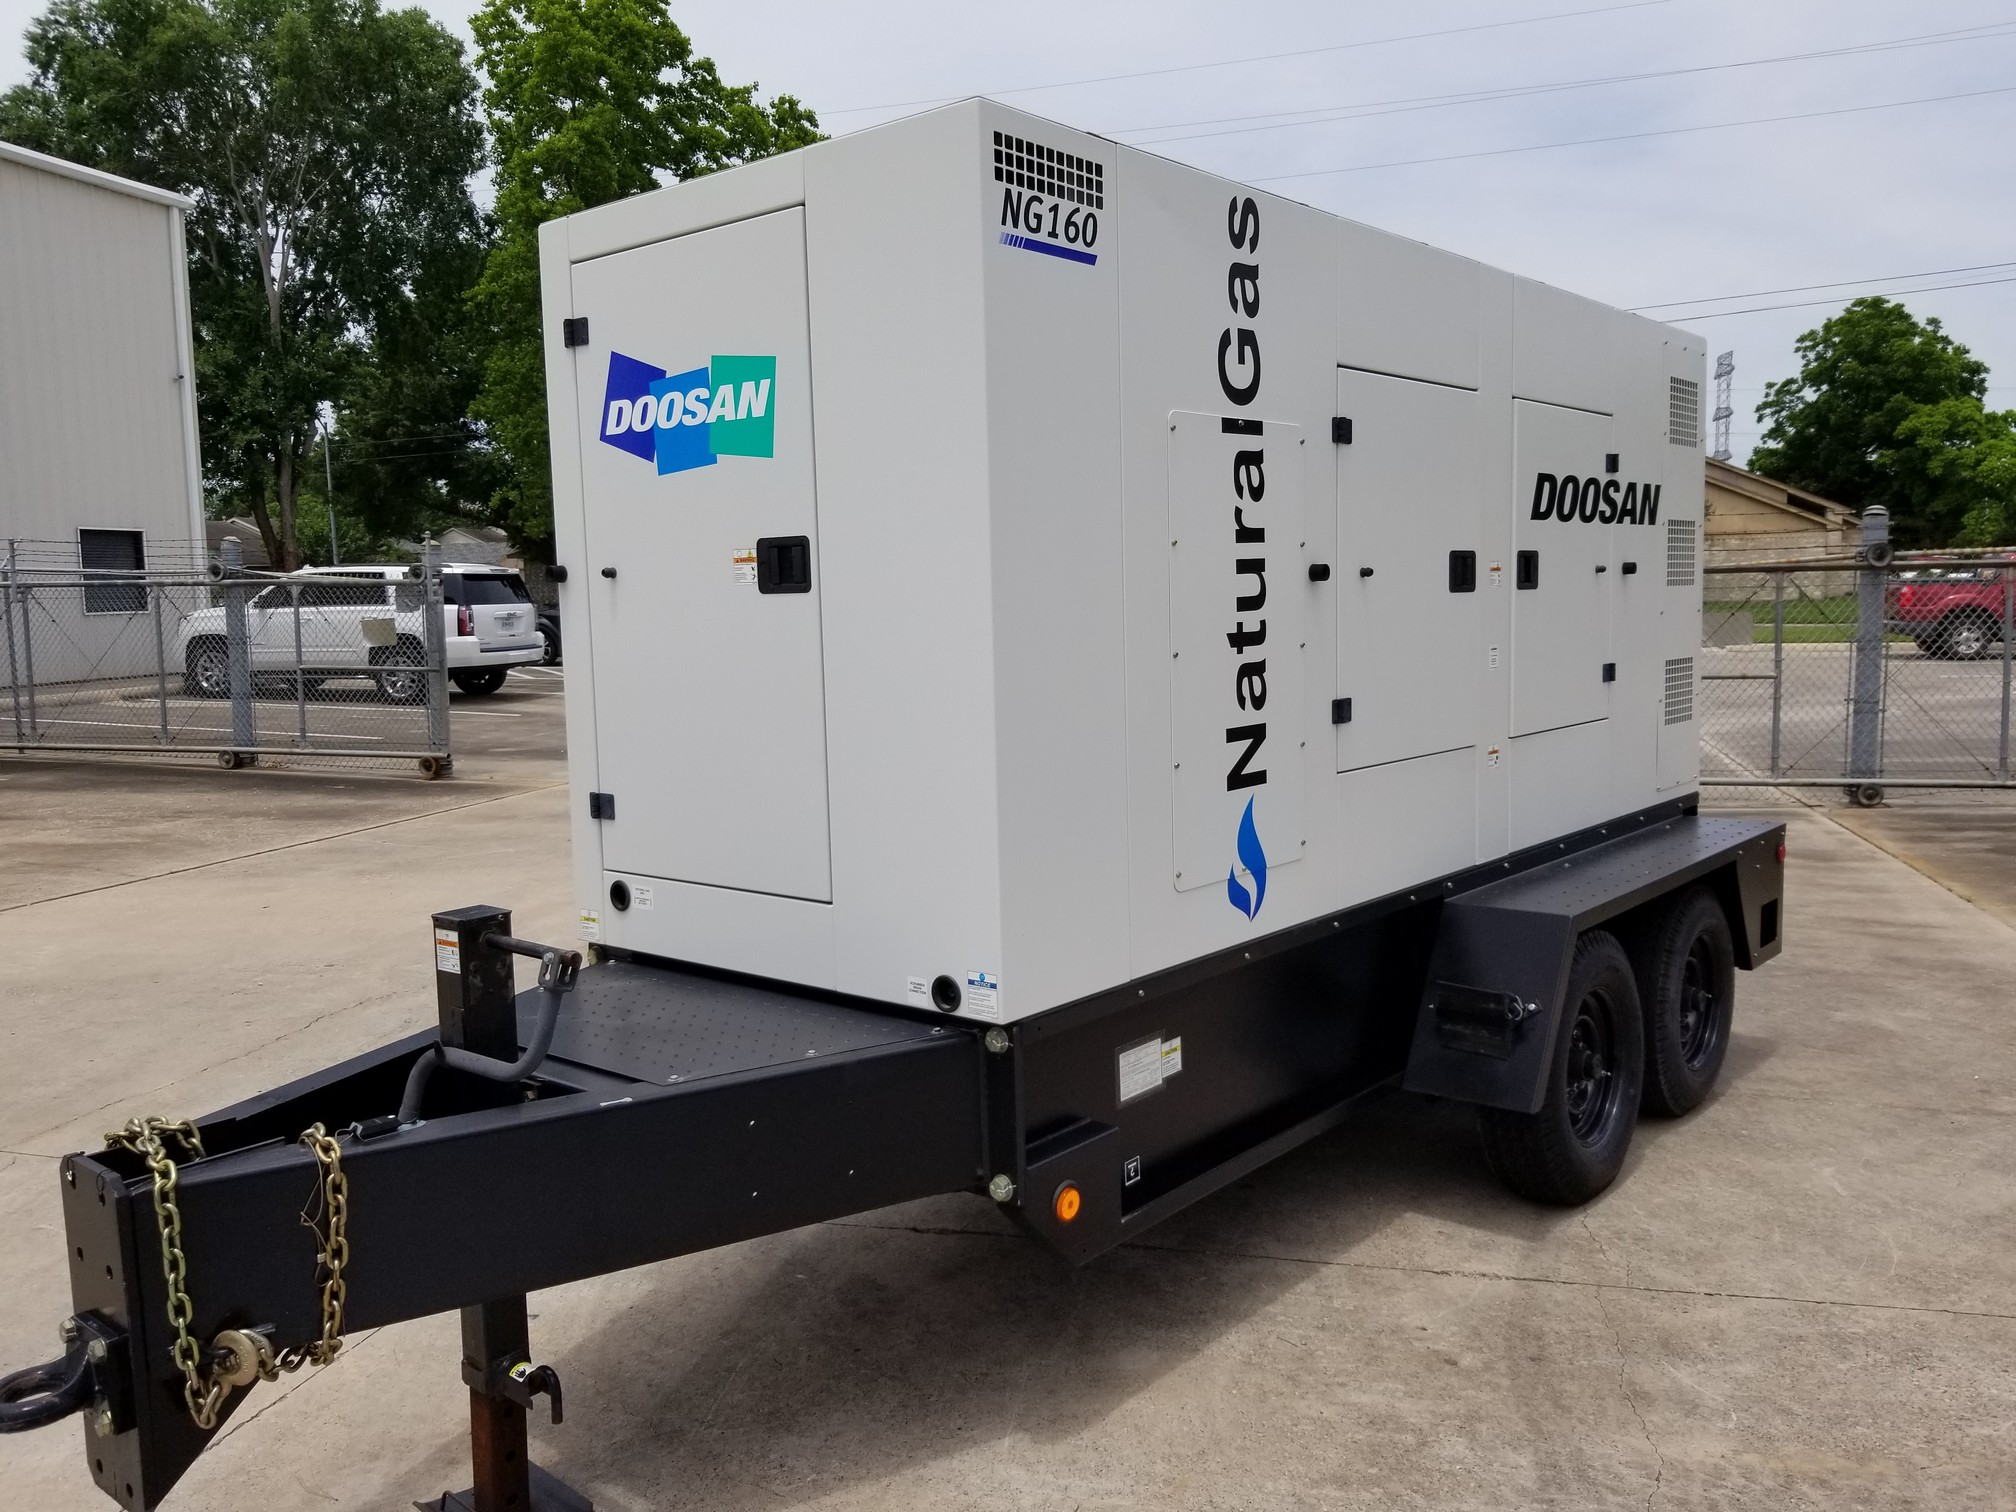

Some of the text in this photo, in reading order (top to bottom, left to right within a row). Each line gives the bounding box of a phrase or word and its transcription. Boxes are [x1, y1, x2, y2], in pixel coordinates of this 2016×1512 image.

[1001, 187, 1098, 248] NG160
[605, 378, 771, 436] DOOSAN
[1530, 472, 1661, 526] DOOSAN
